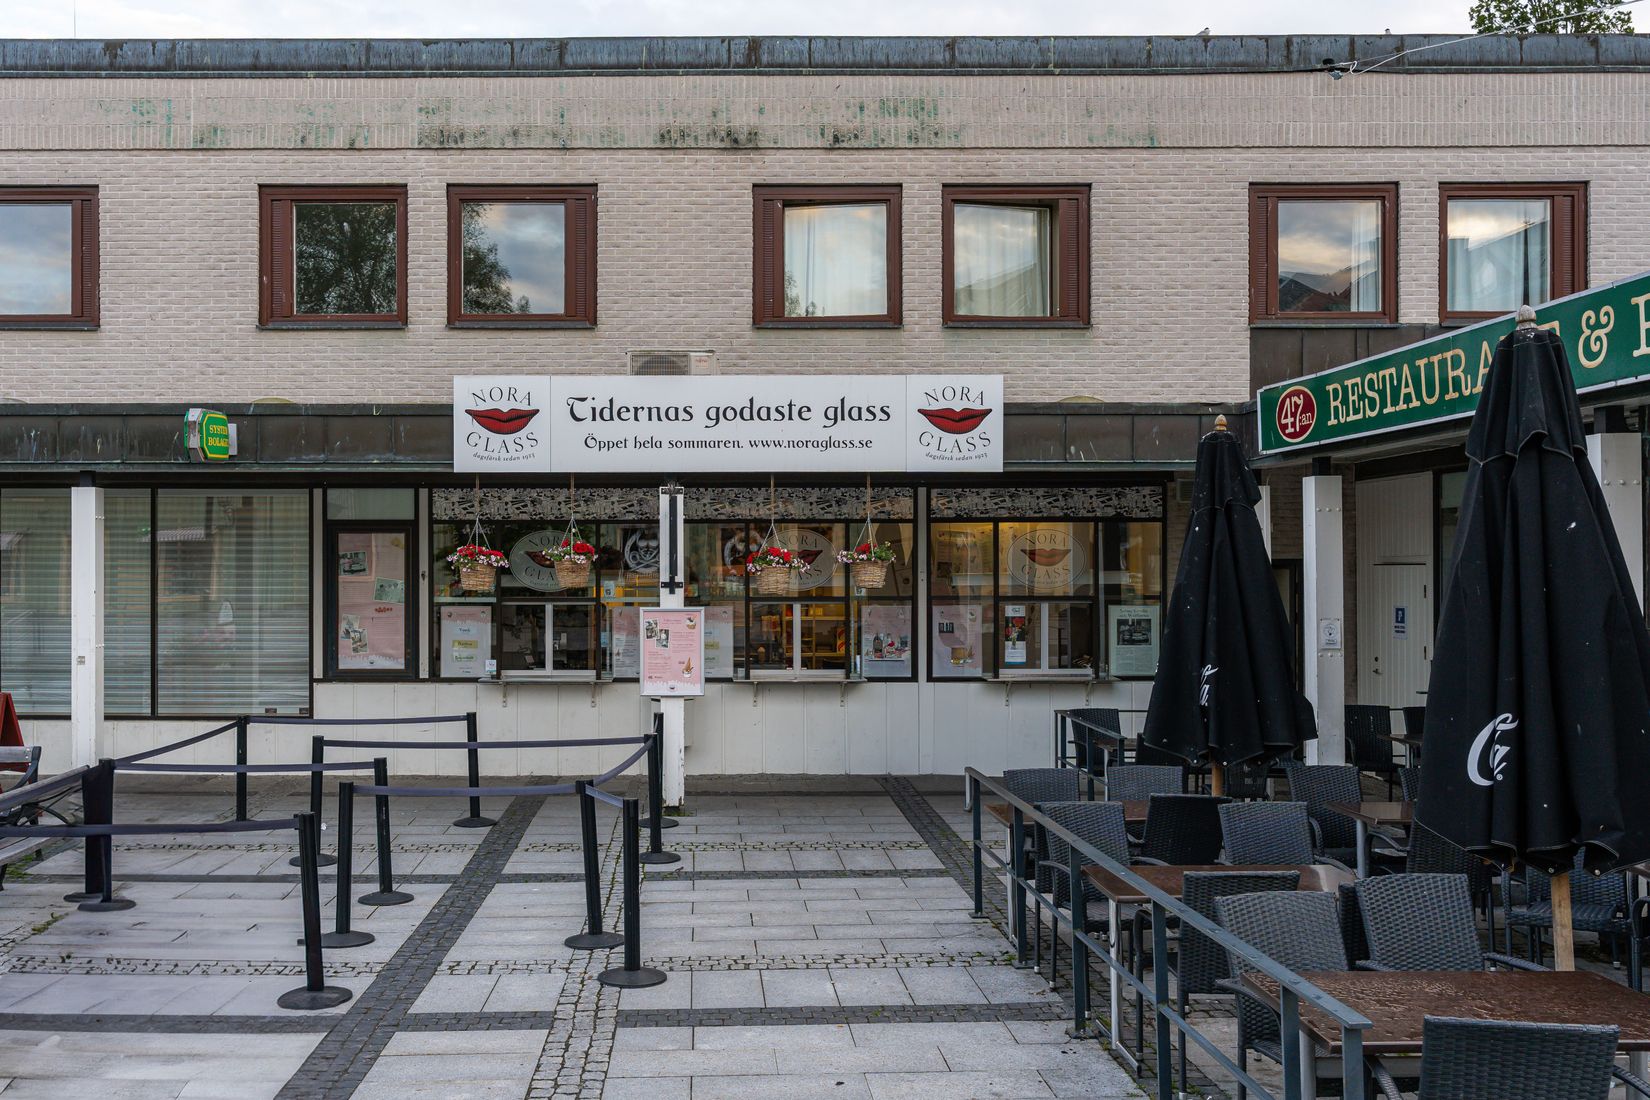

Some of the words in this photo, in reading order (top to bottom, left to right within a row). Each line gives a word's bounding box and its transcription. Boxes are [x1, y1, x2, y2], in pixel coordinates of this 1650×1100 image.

[1577, 305, 1615, 369] &
[471, 386, 532, 406] NORA
[924, 386, 985, 406] NORA
[566, 396, 694, 422] Tidernas
[704, 396, 812, 429] godaste
[823, 396, 891, 429] glass
[466, 431, 539, 454] GLASS
[584, 432, 628, 452] Öppet
[633, 436, 663, 450] hela
[667, 440, 744, 449] sommaren.
[749, 436, 873, 452] www.noraglass.se
[918, 431, 991, 453] GLASS
[527, 535, 561, 547] NOR
